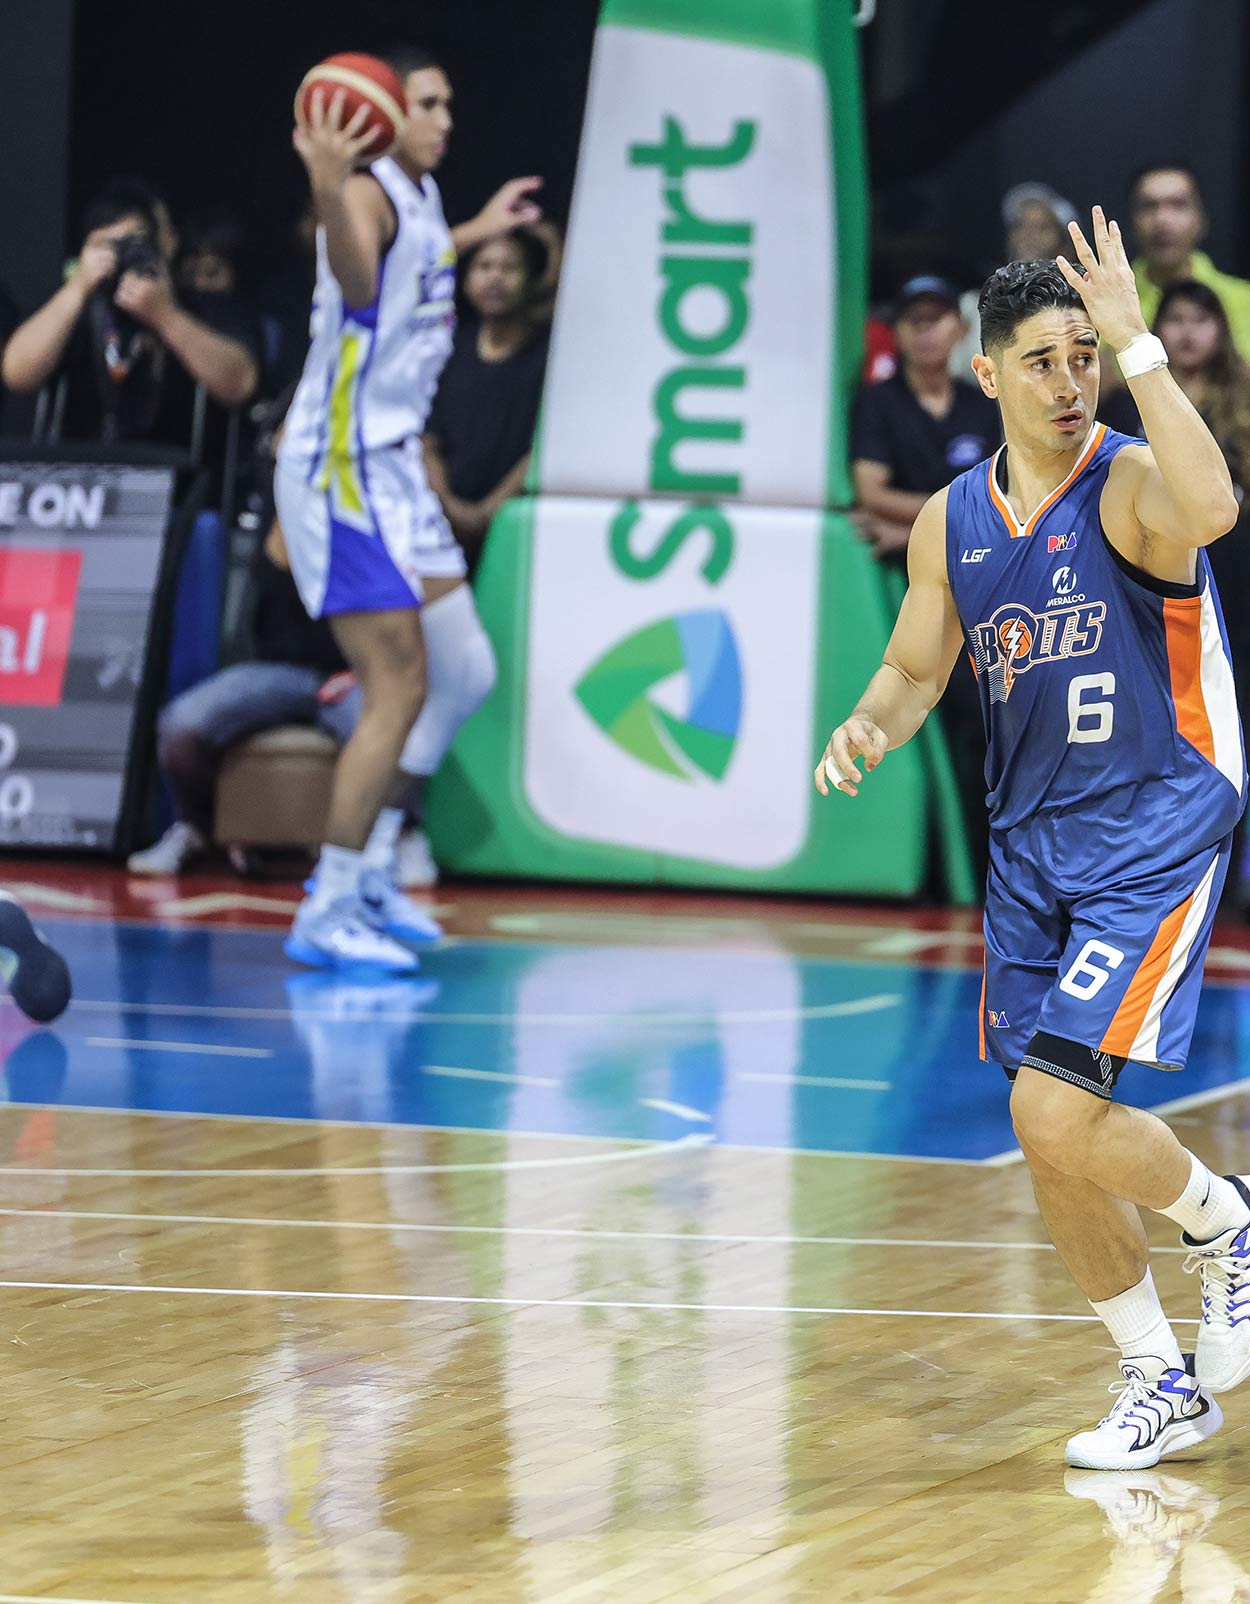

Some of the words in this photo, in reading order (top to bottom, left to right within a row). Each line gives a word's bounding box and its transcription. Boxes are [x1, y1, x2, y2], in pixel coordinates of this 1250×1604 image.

[28, 482, 105, 528] ON
[1048, 532, 1077, 552] PBA
[1046, 593, 1086, 608] MERALCO
[1067, 671, 1116, 744] 6
[1059, 938, 1126, 1001] 6
